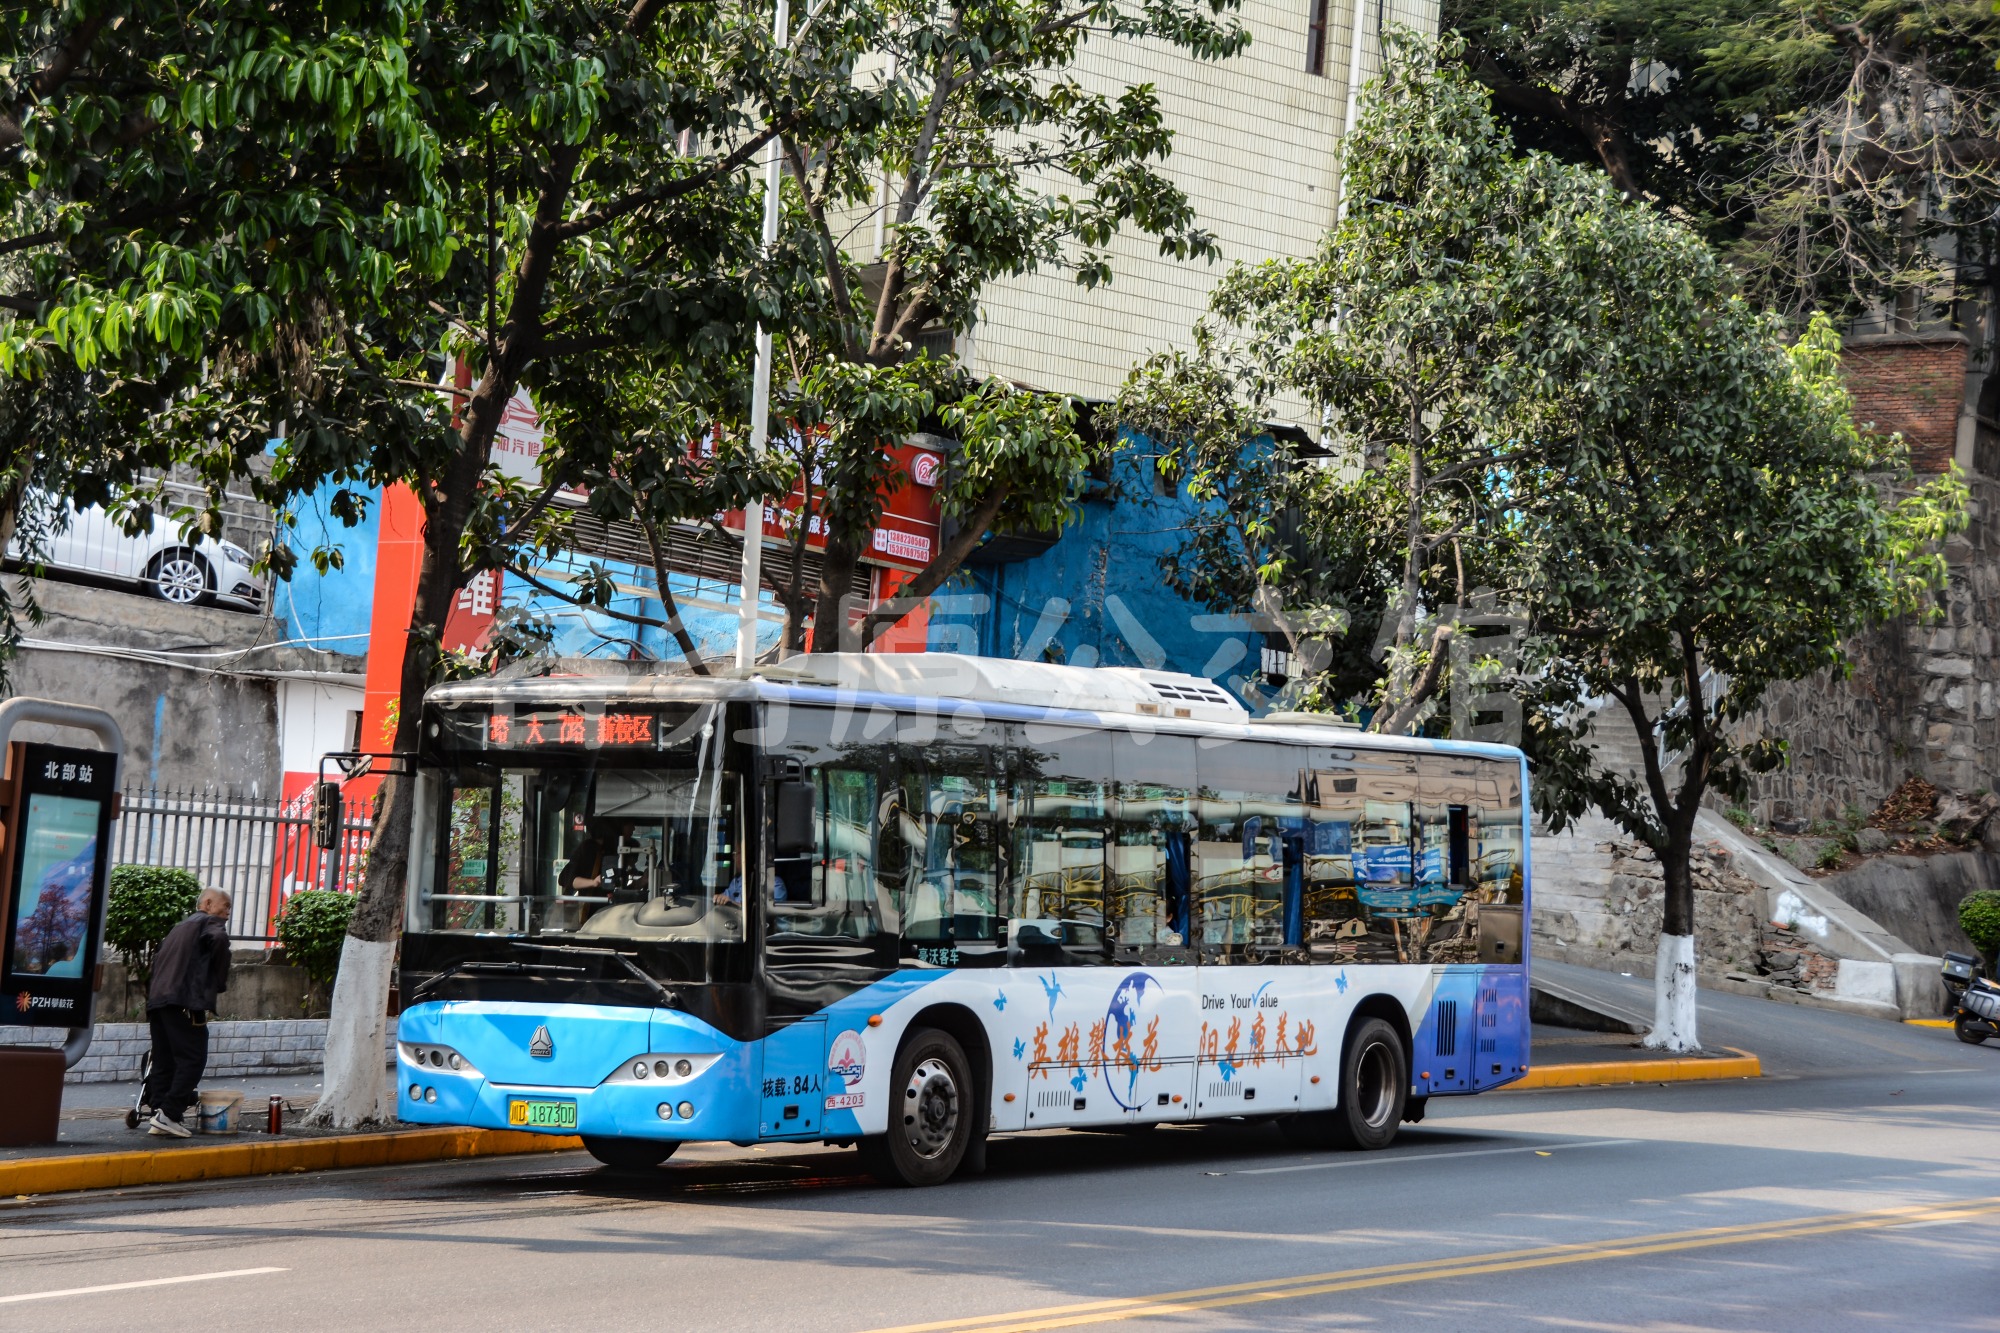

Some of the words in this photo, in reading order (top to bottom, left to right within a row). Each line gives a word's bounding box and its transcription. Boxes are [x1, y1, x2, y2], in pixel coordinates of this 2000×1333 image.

[44, 761, 93, 783] 北部站
[918, 948, 959, 965] 豪沃客车
[1202, 994, 1225, 1010] Drive
[1230, 993, 1251, 1009] Your
[1030, 1014, 1162, 1080] 英雄攀枝花
[1199, 1010, 1318, 1070] 阳光康养地
[827, 1095, 864, 1108] 西-4203
